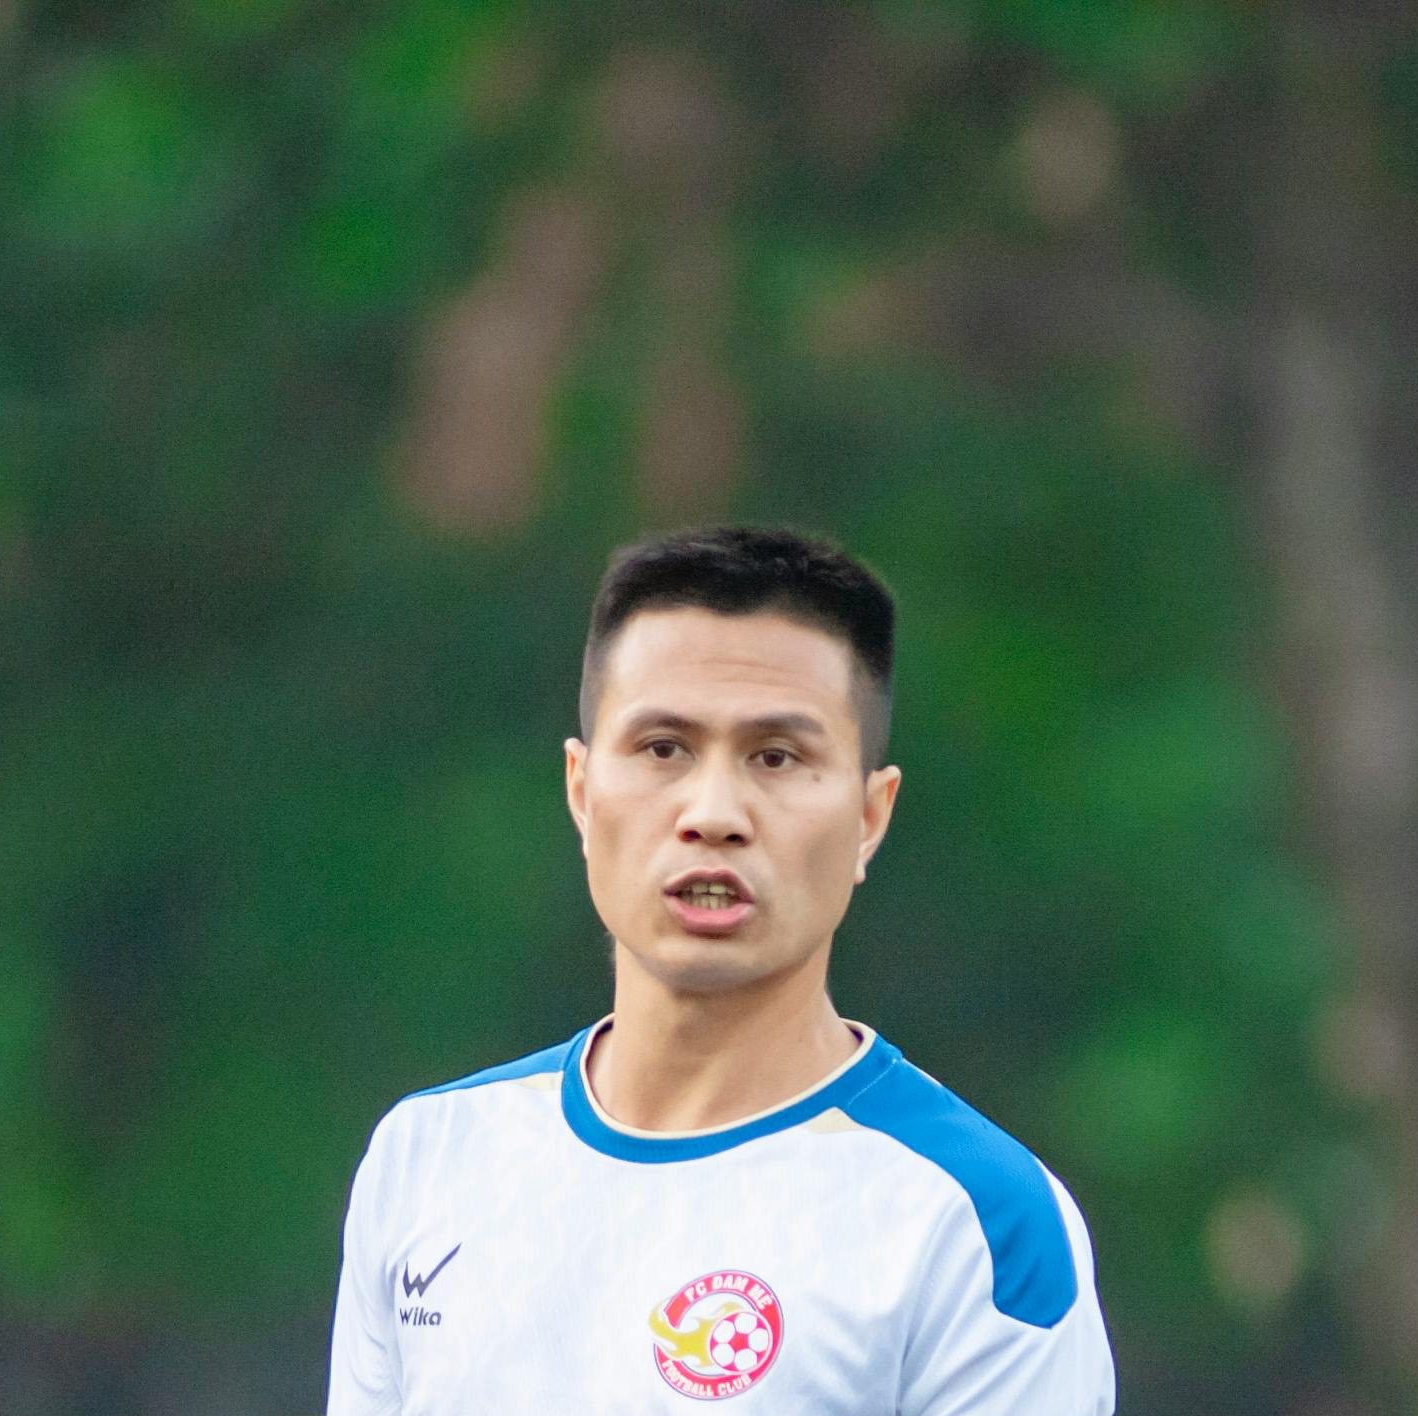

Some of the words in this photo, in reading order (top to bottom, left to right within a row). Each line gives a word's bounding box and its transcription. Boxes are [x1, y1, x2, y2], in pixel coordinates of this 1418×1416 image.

[684, 1281, 707, 1303] FC
[662, 1360, 714, 1396] FOOTBALL
[717, 1373, 752, 1396] CLUB
